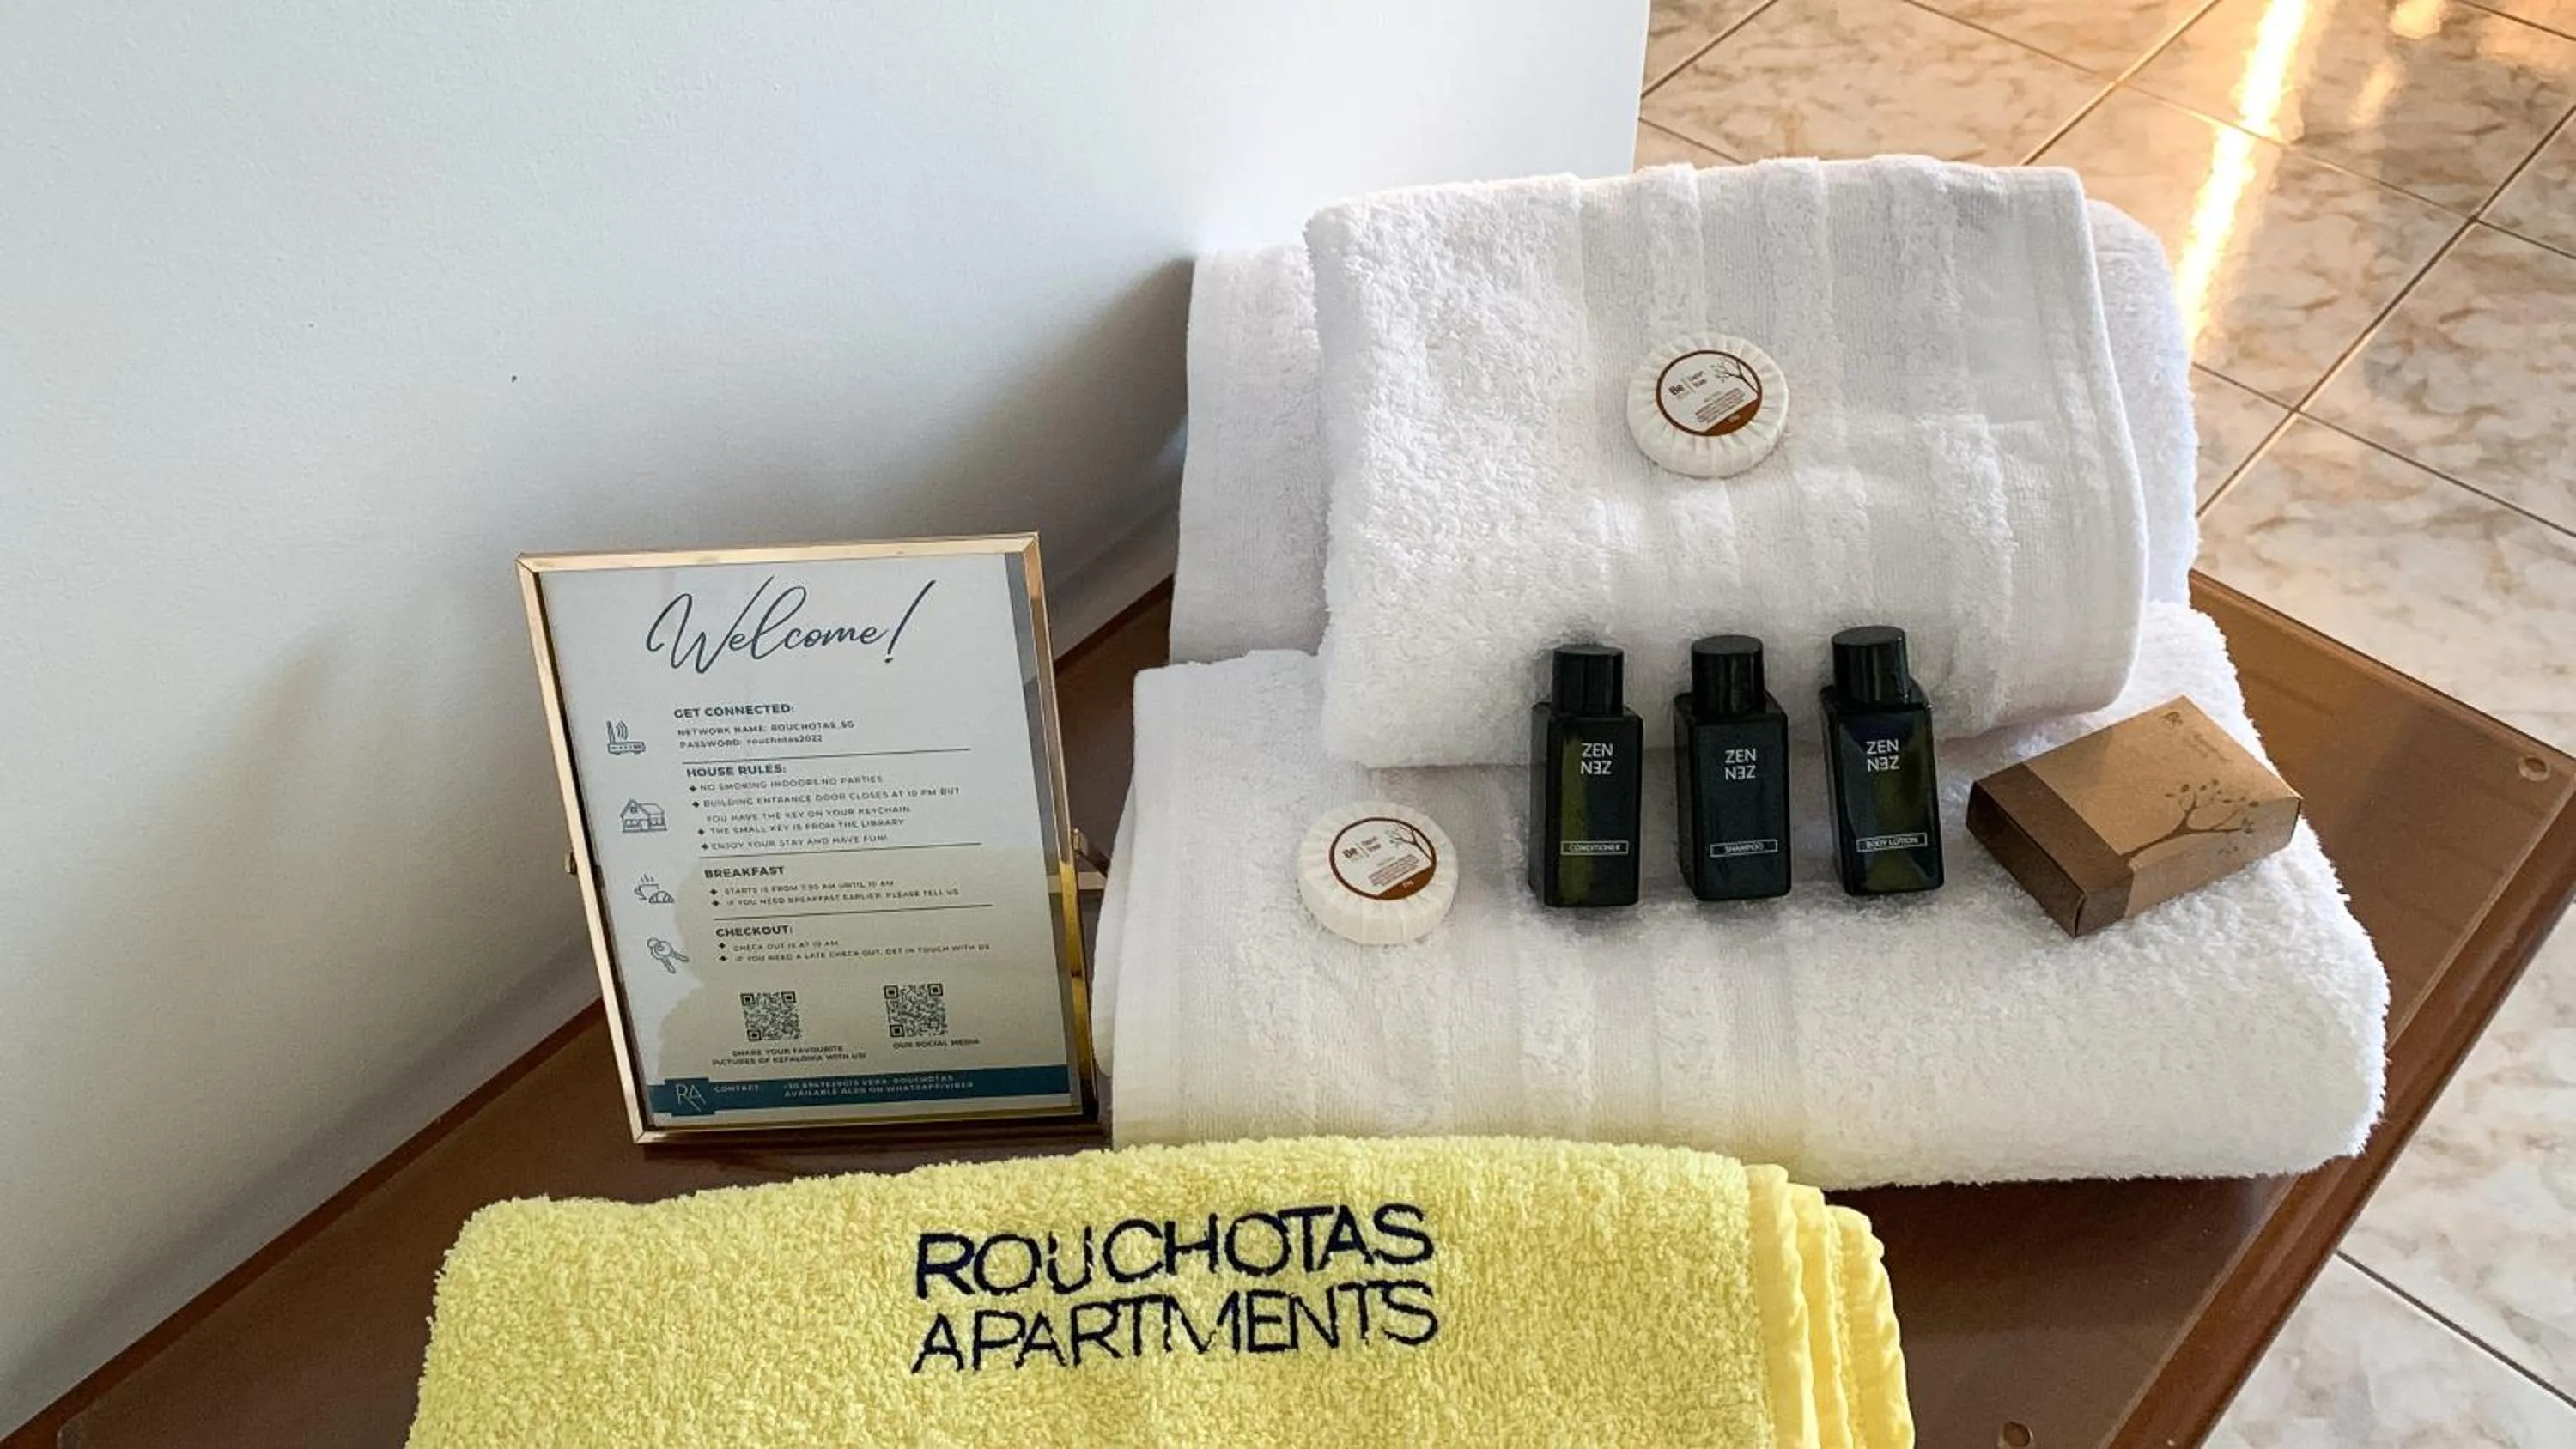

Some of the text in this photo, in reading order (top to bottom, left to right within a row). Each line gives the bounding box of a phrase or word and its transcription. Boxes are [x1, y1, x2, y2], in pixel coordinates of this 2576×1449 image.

[646, 575, 936, 674] Welcome!
[674, 703, 795, 718] GET CONNECTED:
[677, 727, 731, 737] NETWORK
[1581, 743, 1613, 757] ZEN
[1866, 738, 1899, 755] ZEN
[1724, 748, 1756, 764] ZEN
[686, 764, 787, 778] HOUSE RULES:
[719, 781, 768, 791] SMOKING
[841, 775, 883, 784] PARTIES
[703, 798, 754, 808] BUILDING
[757, 794, 811, 804] ENTRANCE
[816, 793, 846, 802] DOOR
[848, 791, 889, 800] CLOSES
[920, 787, 937, 796] PM
[940, 786, 960, 796] BUT
[732, 813, 758, 822] HAVE
[762, 811, 781, 820] THE
[785, 810, 805, 819] KEY
[826, 807, 855, 816] YOUR
[859, 805, 911, 815] KEYCHAIN
[710, 818, 906, 835] THE SMALL KEY IS FROM THE LIBRARY
[711, 842, 744, 851] ENJOY
[748, 840, 775, 848] YOUR
[779, 838, 804, 847] STAY
[832, 835, 860, 844] HAVE
[1569, 844, 1620, 852] CONDITIONER
[1724, 842, 1765, 852] SHAMPOO
[1866, 837, 1919, 849] BODY LOTION
[704, 865, 785, 878] BREAKFAST
[725, 886, 758, 895] STARTS
[838, 881, 866, 889] UNTIL
[787, 894, 840, 904] BREAKFAST
[885, 890, 920, 899] PLEASE
[923, 888, 944, 897] TELL
[946, 888, 959, 896] US
[715, 925, 793, 937] CHECKOUT:
[733, 943, 762, 952] CHECK
[805, 951, 825, 960] LATE
[829, 949, 858, 958] CHECK
[918, 945, 949, 954] TOUCH
[951, 943, 975, 952] WITH
[732, 1045, 843, 1057] SHARE YOUR FAVOURITE
[893, 1038, 980, 1049] OUR SOCIAL MEDIA
[712, 1057, 756, 1067] PICTURES
[773, 1055, 823, 1064] KEFALONIA
[826, 1052, 848, 1061] WITH
[675, 1084, 707, 1113] RA
[784, 1088, 837, 1098] AVAILABLE
[841, 1086, 866, 1094] ALSO
[868, 1085, 884, 1094] ON
[915, 1203, 1434, 1299] ROUCHOTAS
[911, 1279, 1438, 1374] APARTMENTS
